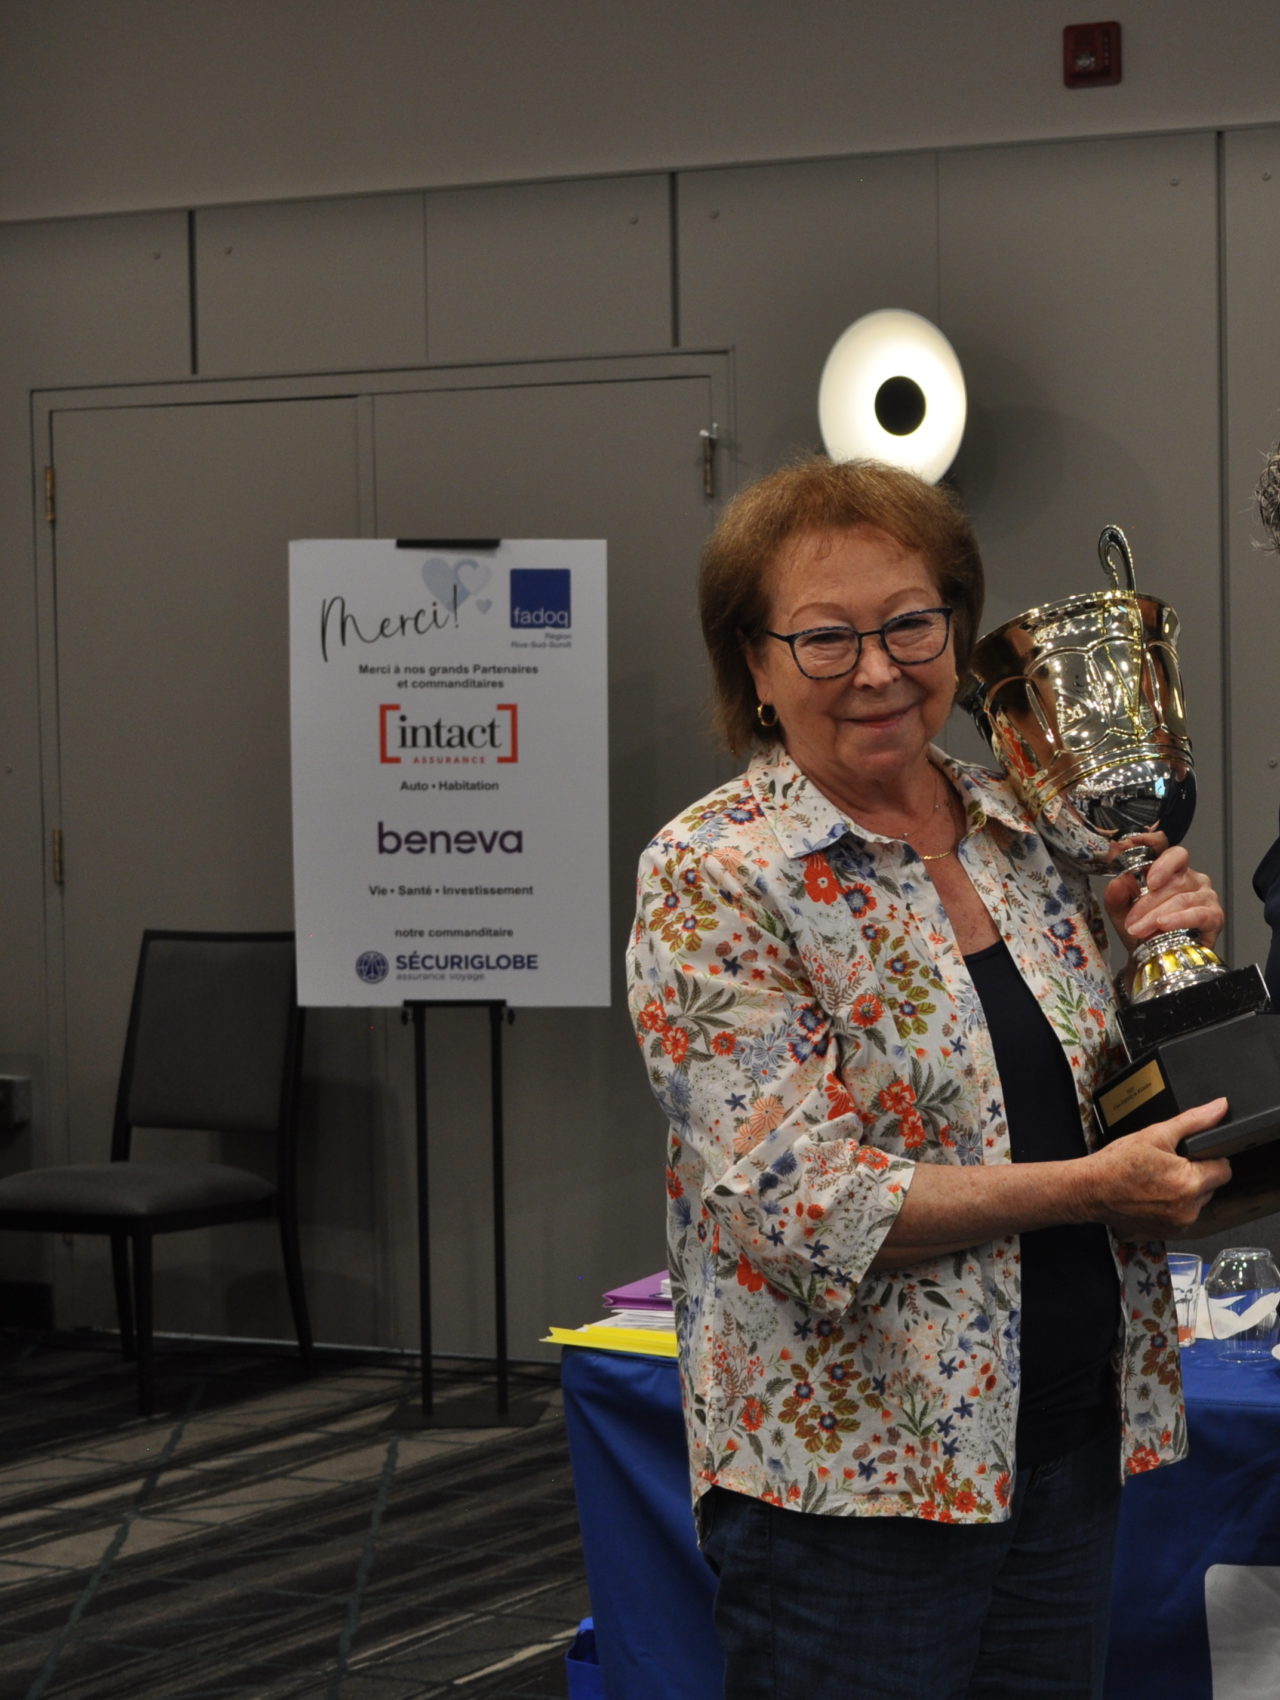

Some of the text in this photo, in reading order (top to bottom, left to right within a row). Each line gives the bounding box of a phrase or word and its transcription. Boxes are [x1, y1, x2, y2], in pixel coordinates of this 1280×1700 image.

[320, 583, 461, 663] Merci!
[512, 607, 570, 628] fadoq
[358, 663, 539, 677] Merci à nos grands Partenaires
[396, 678, 505, 689] et commanditaires
[398, 714, 503, 749] intact
[412, 756, 486, 764] ASSURANCE
[400, 780, 499, 792] Auto Habitation
[377, 820, 523, 855] beneva
[368, 885, 534, 896] Vie Santé Investissement
[394, 927, 514, 938] notre commanditaire
[395, 951, 540, 971] SÉCURIGLOBE
